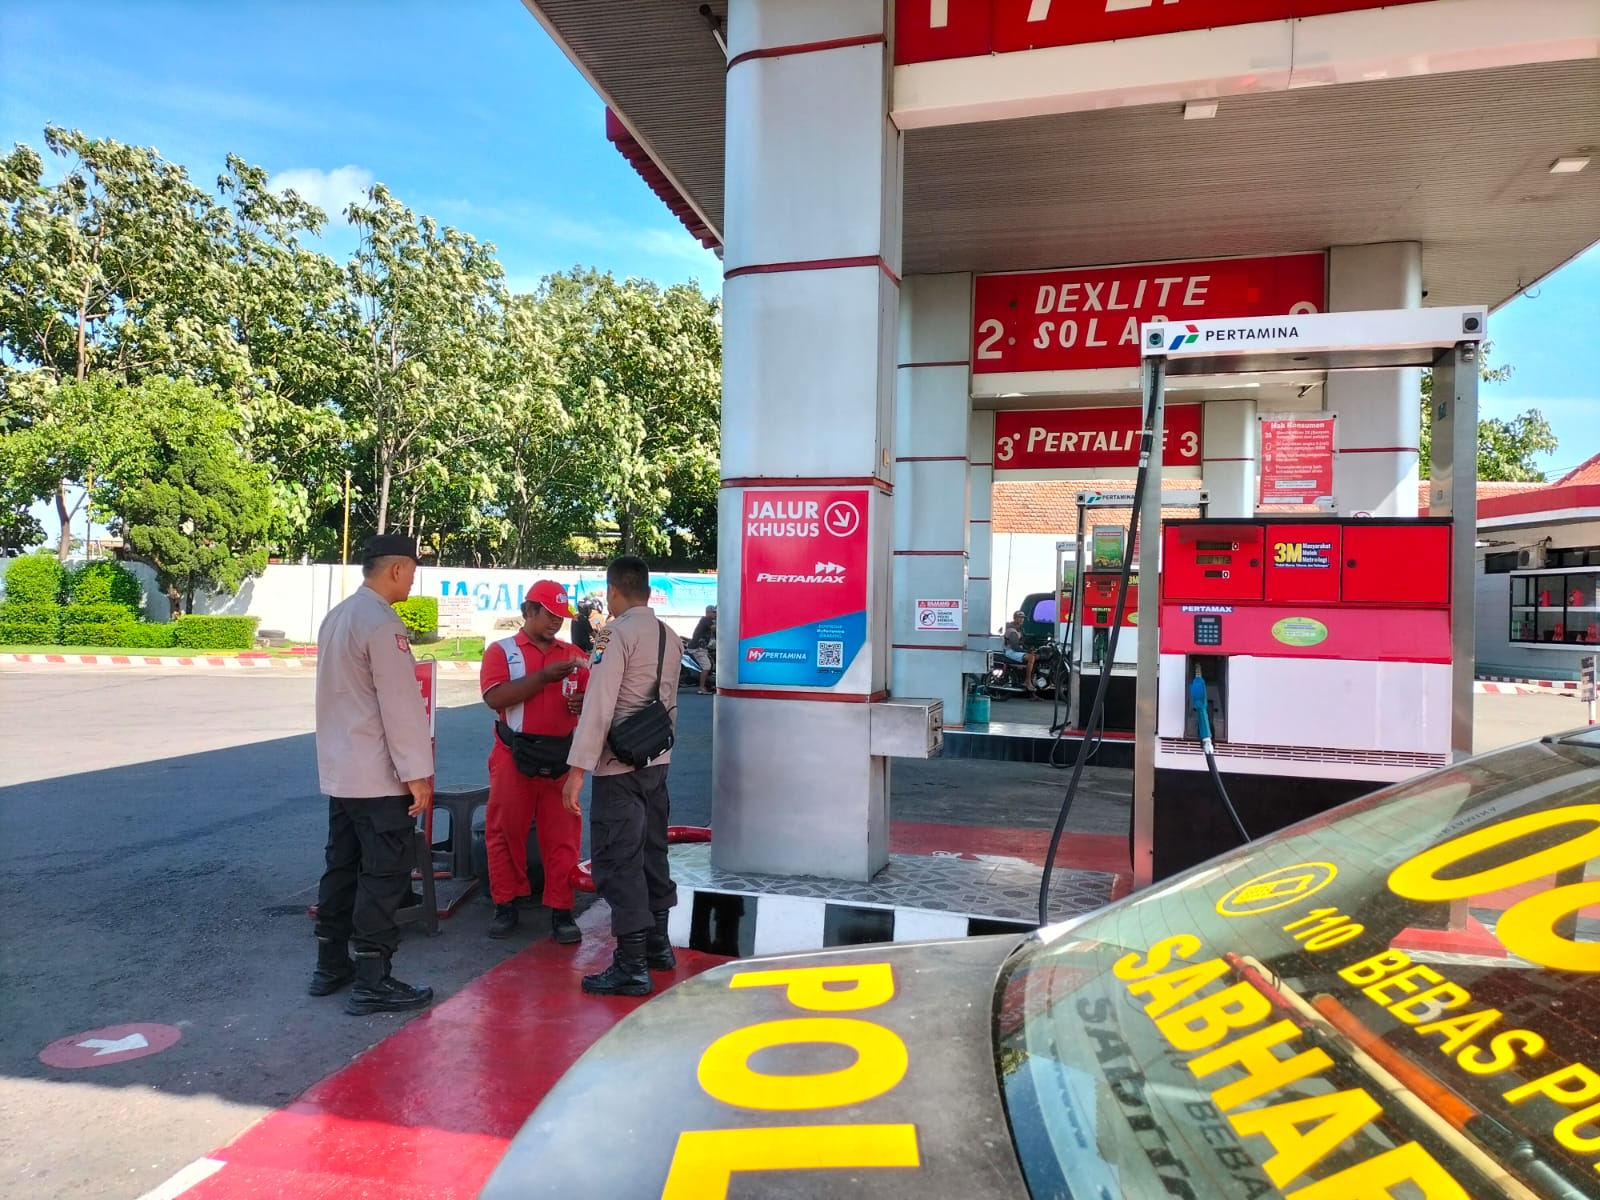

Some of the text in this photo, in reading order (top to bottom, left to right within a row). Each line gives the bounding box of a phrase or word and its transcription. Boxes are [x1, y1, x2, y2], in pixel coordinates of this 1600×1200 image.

[1034, 275, 1212, 315] DEXLITE
[1205, 326, 1299, 342] PERTAMINA
[1287, 421, 1325, 429] Konsumen
[1180, 431, 1199, 457] 3
[748, 501, 819, 520] JALUR
[747, 522, 820, 537] KHUSUS
[1274, 543, 1302, 563] 3M
[756, 573, 847, 584] PERTAMAX
[440, 580, 578, 611] AGAH
[1181, 605, 1233, 613] PERTAMAX
[1283, 907, 1600, 1174] 110 BEBAS PU
[661, 963, 920, 1200] POL
